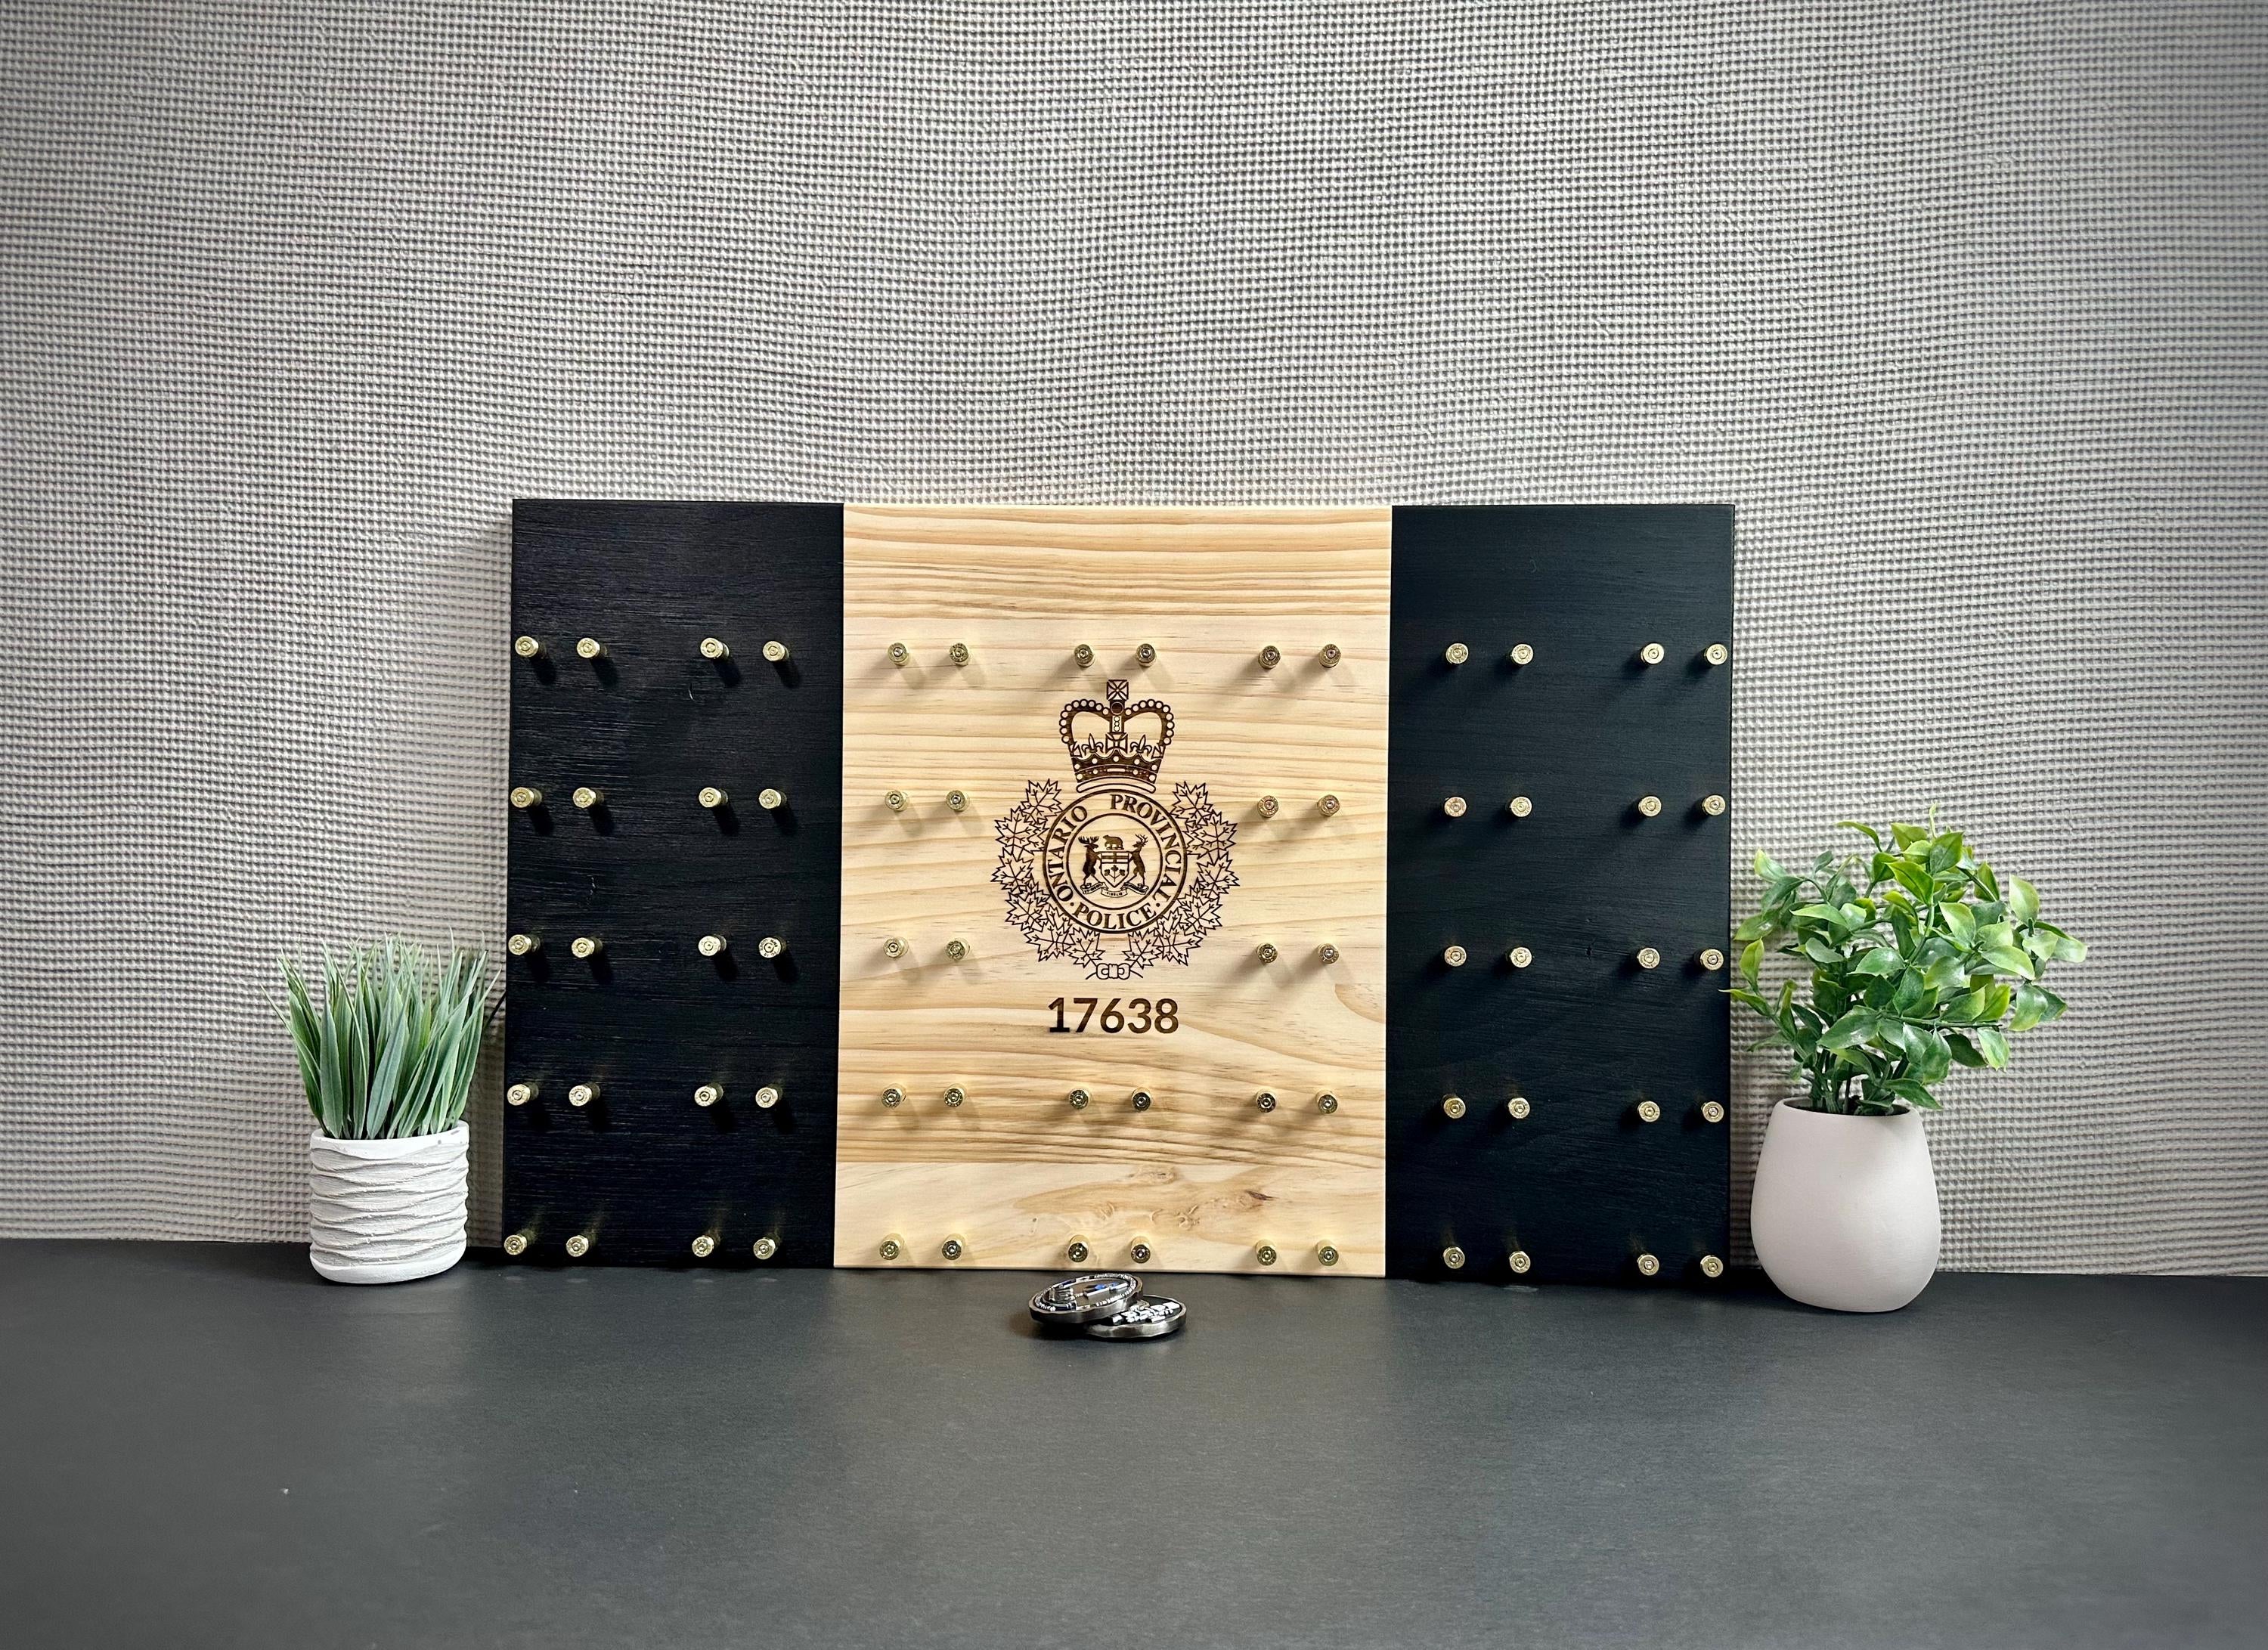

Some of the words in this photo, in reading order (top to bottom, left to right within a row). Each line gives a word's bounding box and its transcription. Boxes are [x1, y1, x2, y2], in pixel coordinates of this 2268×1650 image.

[1048, 806, 1088, 902] ONTARIO
[1110, 794, 1182, 902] PROVINCIAL
[1072, 902, 1157, 930] POLICE
[1048, 997, 1179, 1034] 17638
